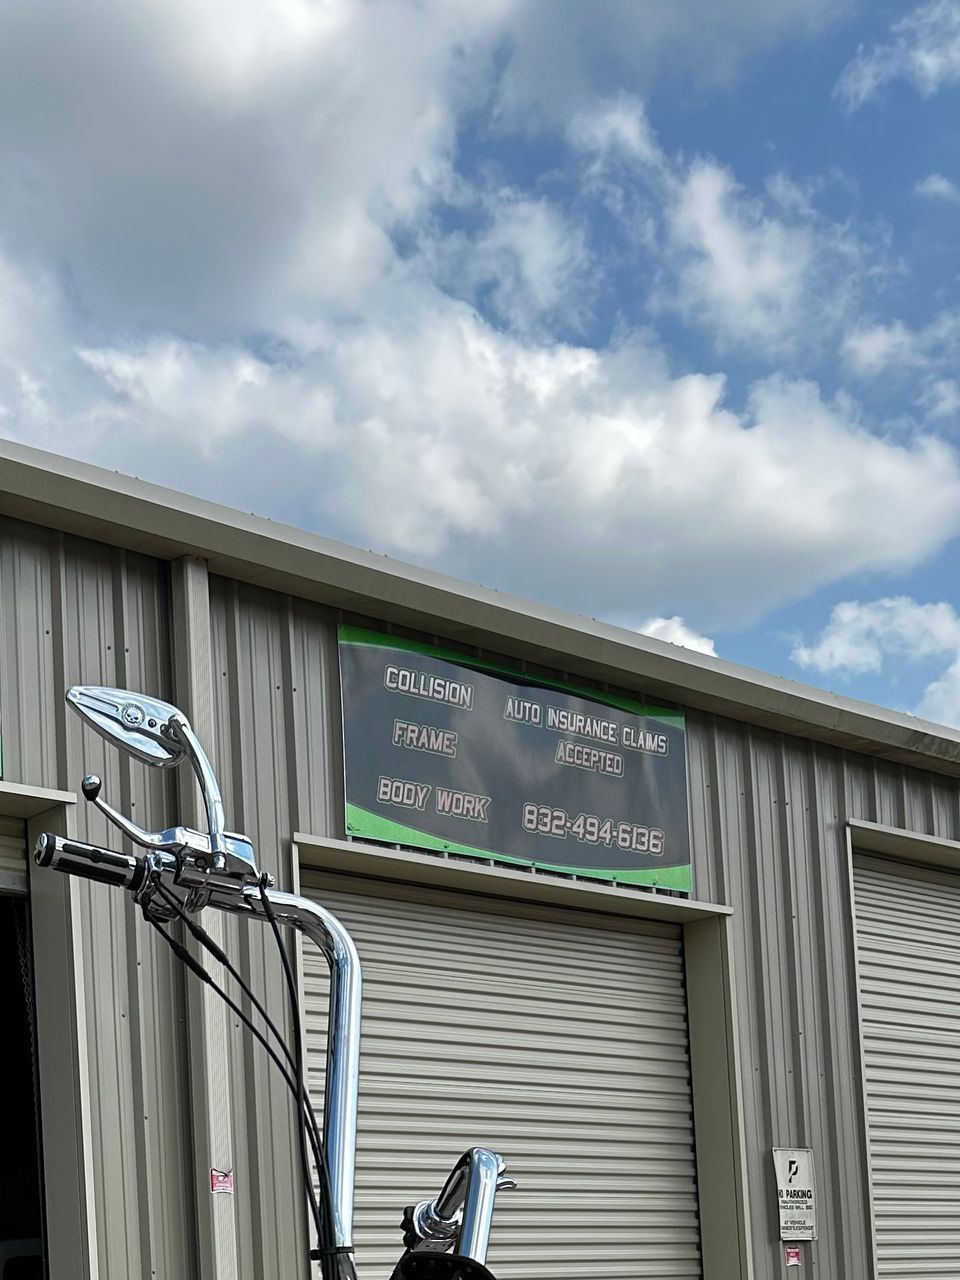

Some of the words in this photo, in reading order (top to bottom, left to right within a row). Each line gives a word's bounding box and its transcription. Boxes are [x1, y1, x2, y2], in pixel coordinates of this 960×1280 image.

[385, 665, 473, 709] COLLISION
[393, 720, 457, 757] FRAME
[505, 698, 541, 725] AUTO
[546, 708, 618, 742] INSURANCE
[622, 726, 668, 755] CLAIMS
[556, 742, 624, 776] ACCEPTED
[378, 778, 429, 809] BODY
[436, 788, 490, 821] WORK
[522, 803, 665, 855] 832-494-6136
[786, 1189, 812, 1199] PARKING
